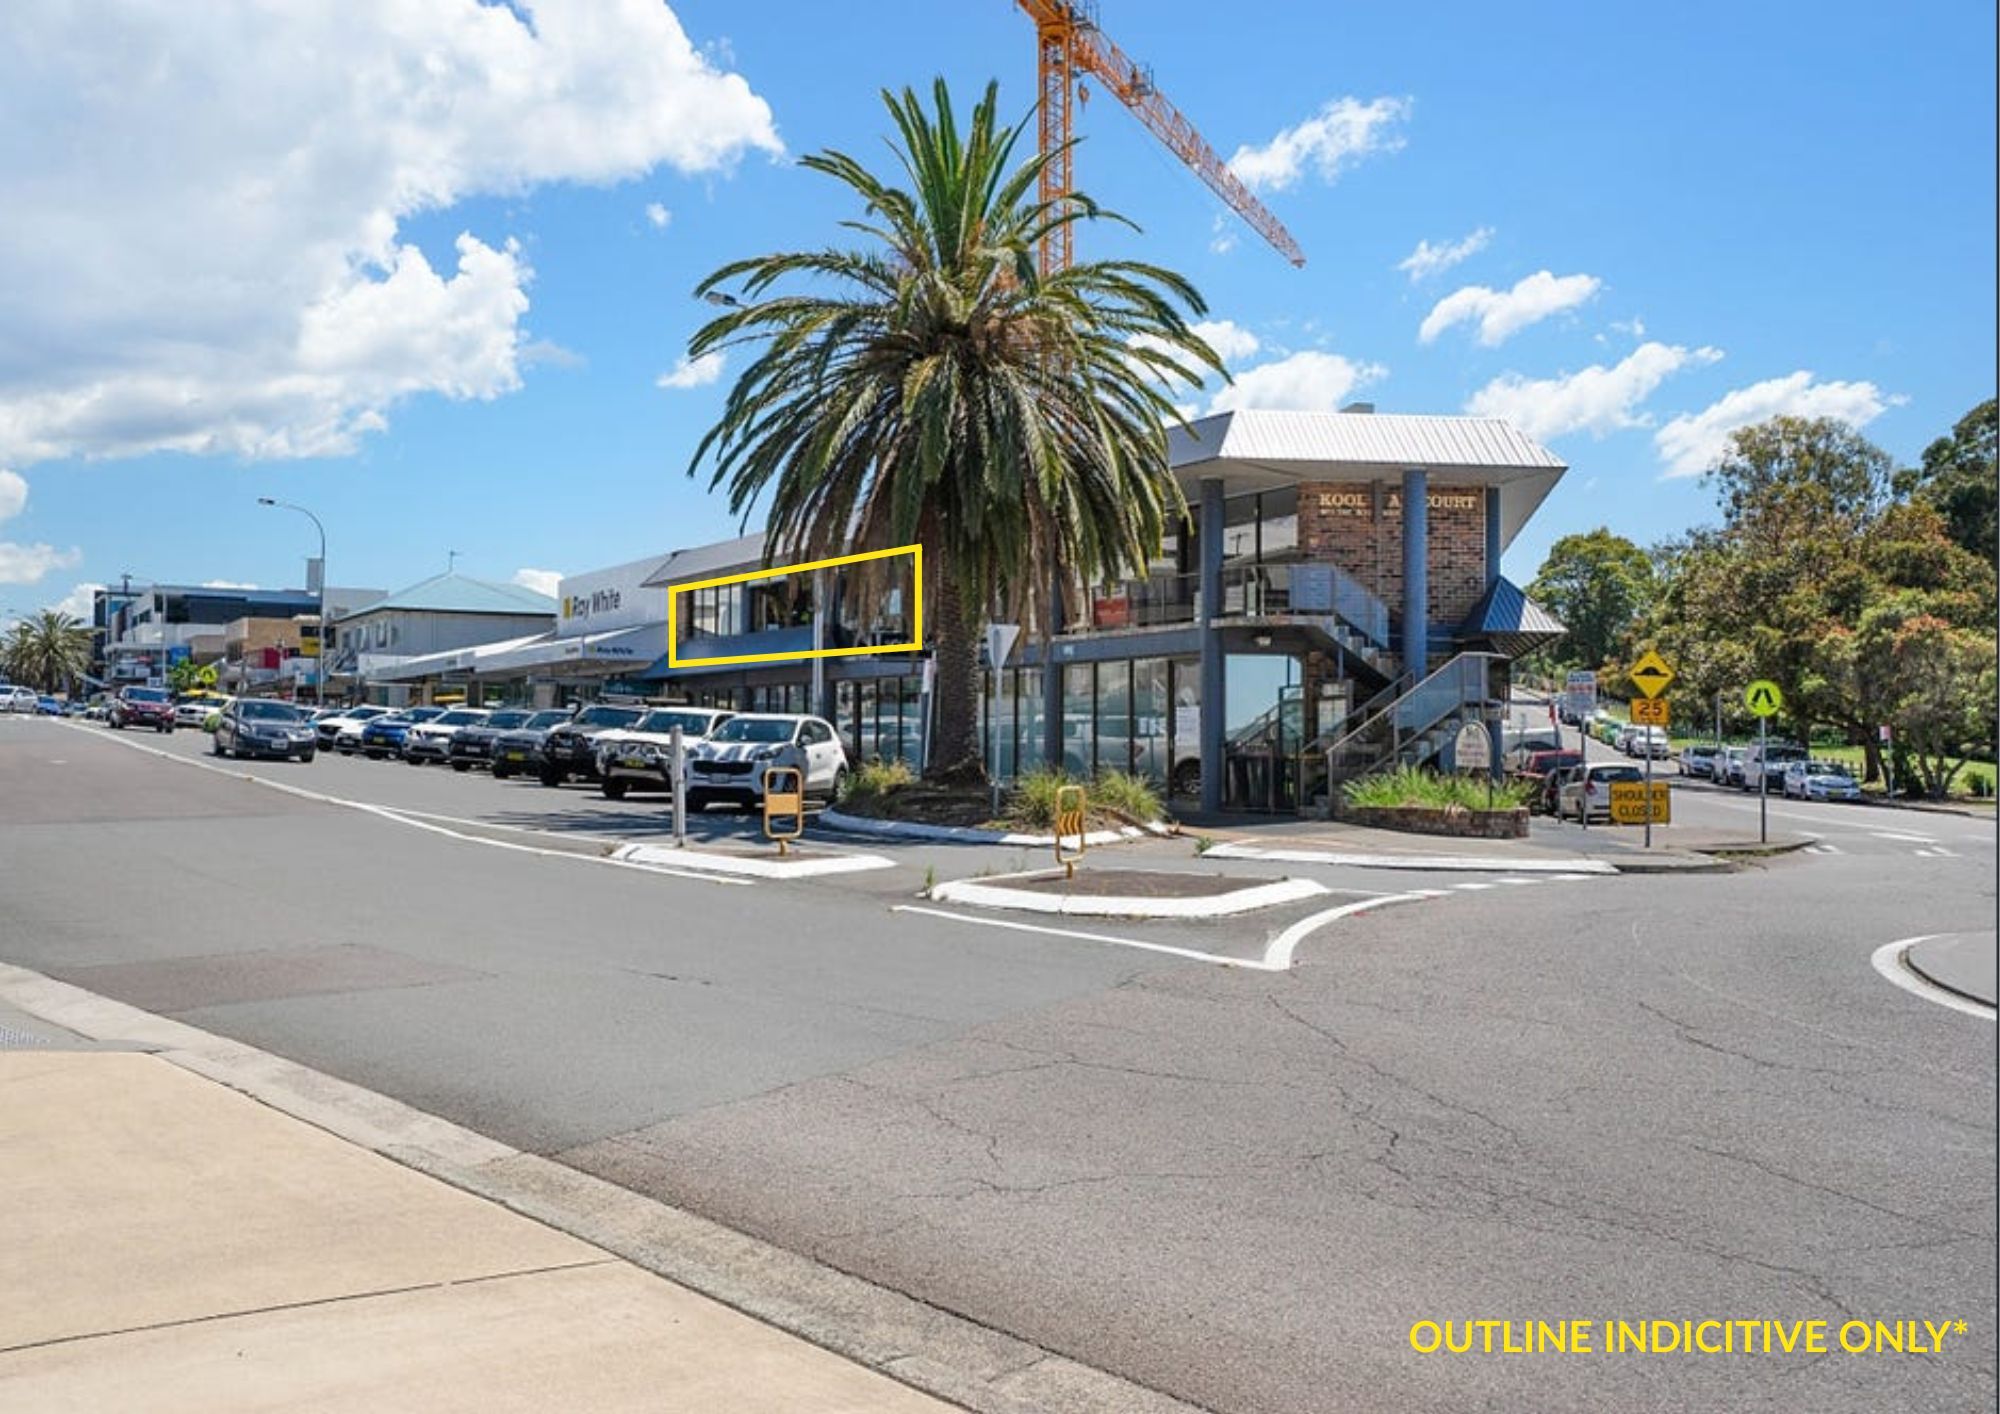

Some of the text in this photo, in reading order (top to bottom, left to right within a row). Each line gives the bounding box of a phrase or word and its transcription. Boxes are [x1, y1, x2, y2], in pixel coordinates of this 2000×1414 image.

[573, 588, 621, 620] Ray White
[1638, 702, 1662, 717] 25
